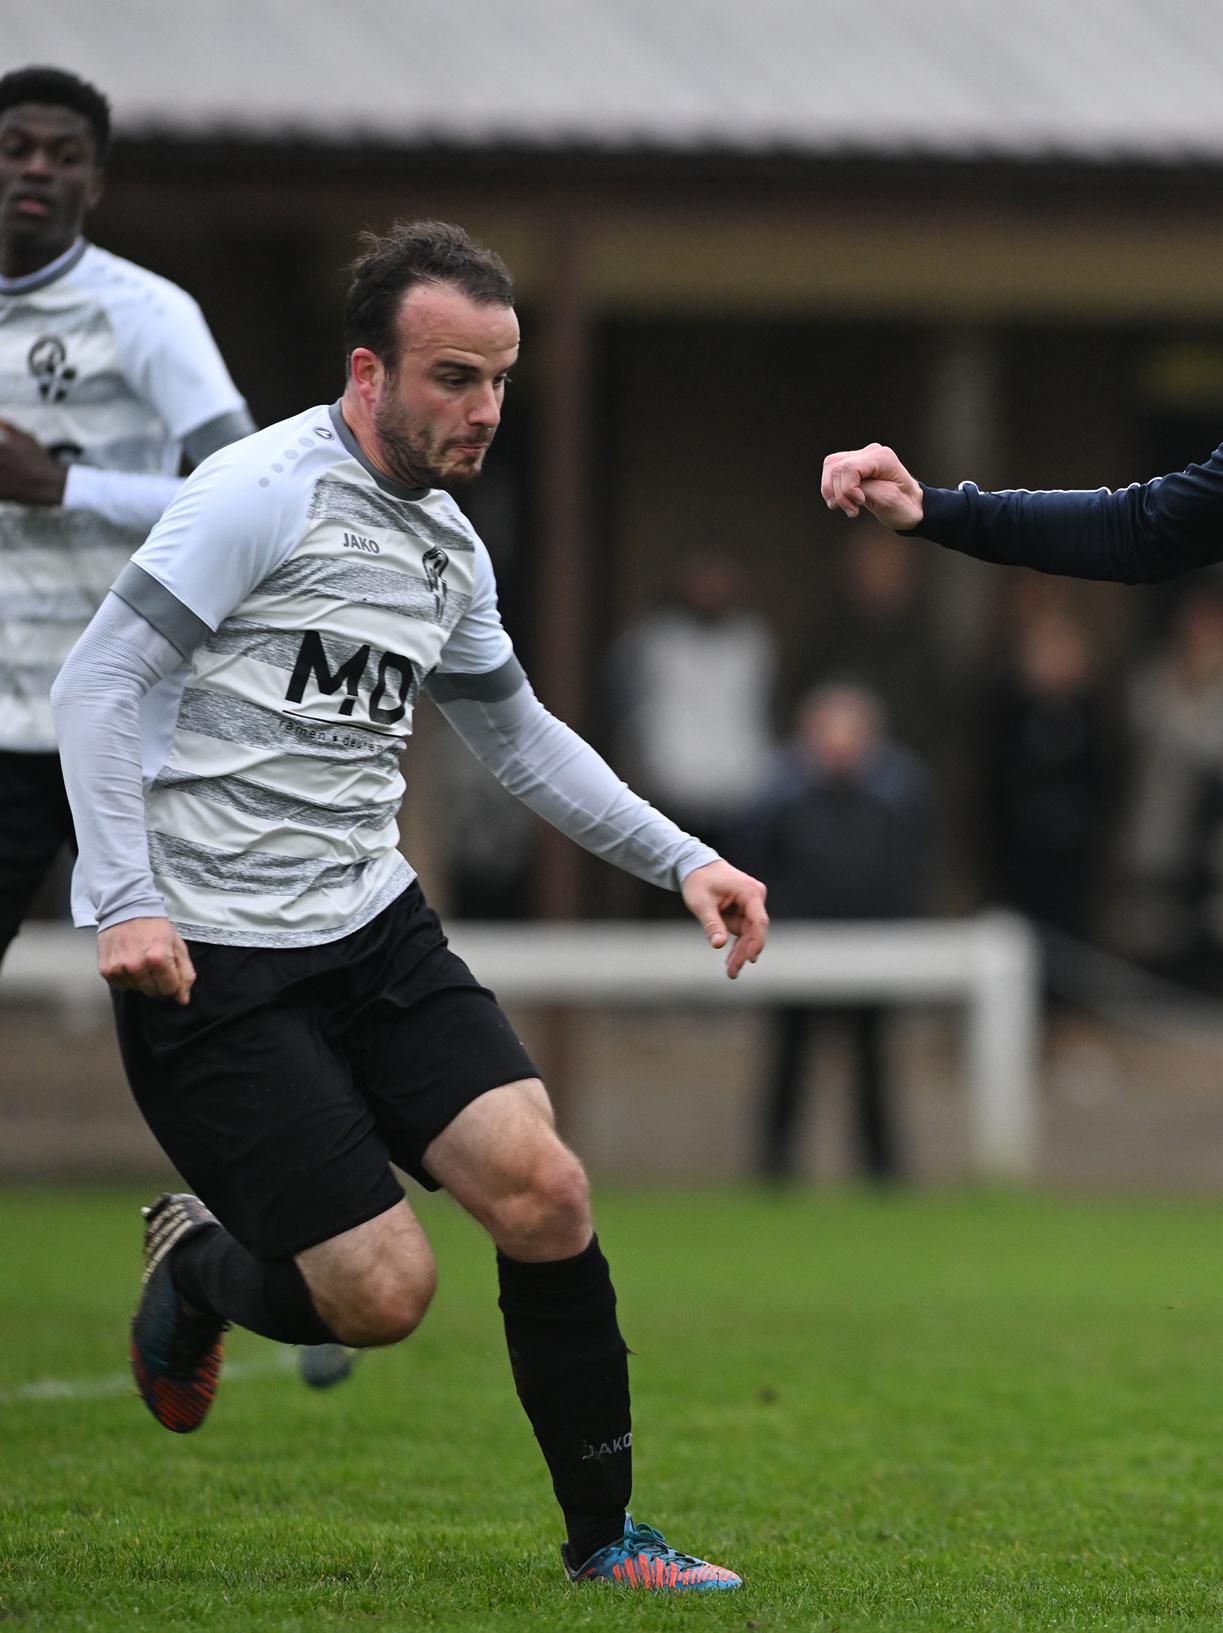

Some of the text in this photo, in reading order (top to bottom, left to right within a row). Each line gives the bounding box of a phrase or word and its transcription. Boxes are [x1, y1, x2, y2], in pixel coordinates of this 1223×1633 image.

[342, 532, 380, 554] JAKO
[285, 630, 437, 726] MO
[582, 1432, 633, 1460] JAKO
